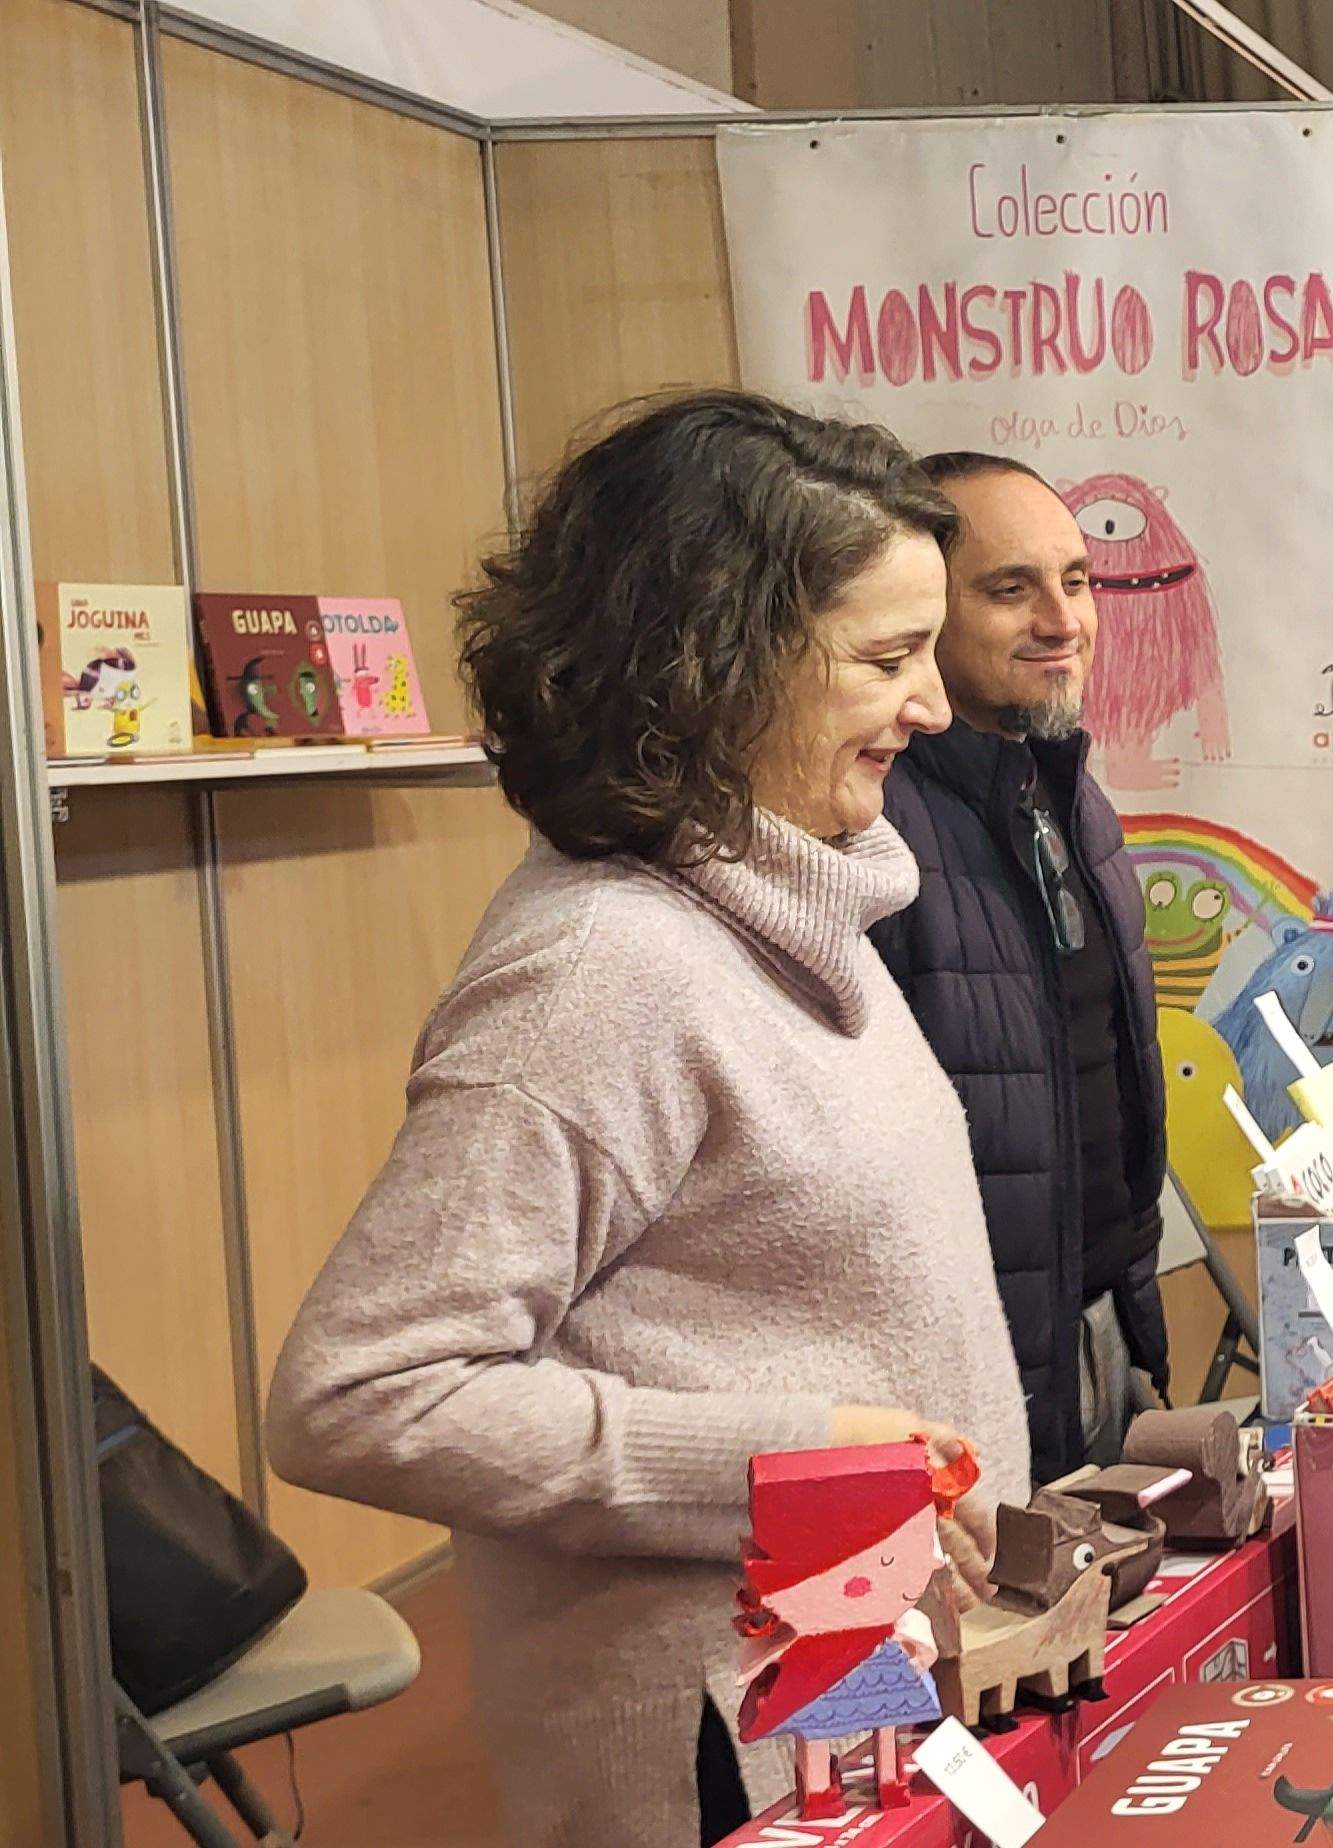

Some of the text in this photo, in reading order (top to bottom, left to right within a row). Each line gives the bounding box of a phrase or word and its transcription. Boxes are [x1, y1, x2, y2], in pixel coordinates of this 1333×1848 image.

[969, 162, 1169, 239] Colección
[806, 270, 1154, 388] MONSTRUO
[1068, 401, 1105, 438] de
[67, 609, 150, 630] JOGUINA
[231, 608, 299, 636] GUAPA
[1111, 1718, 1251, 1817] GUAPA
